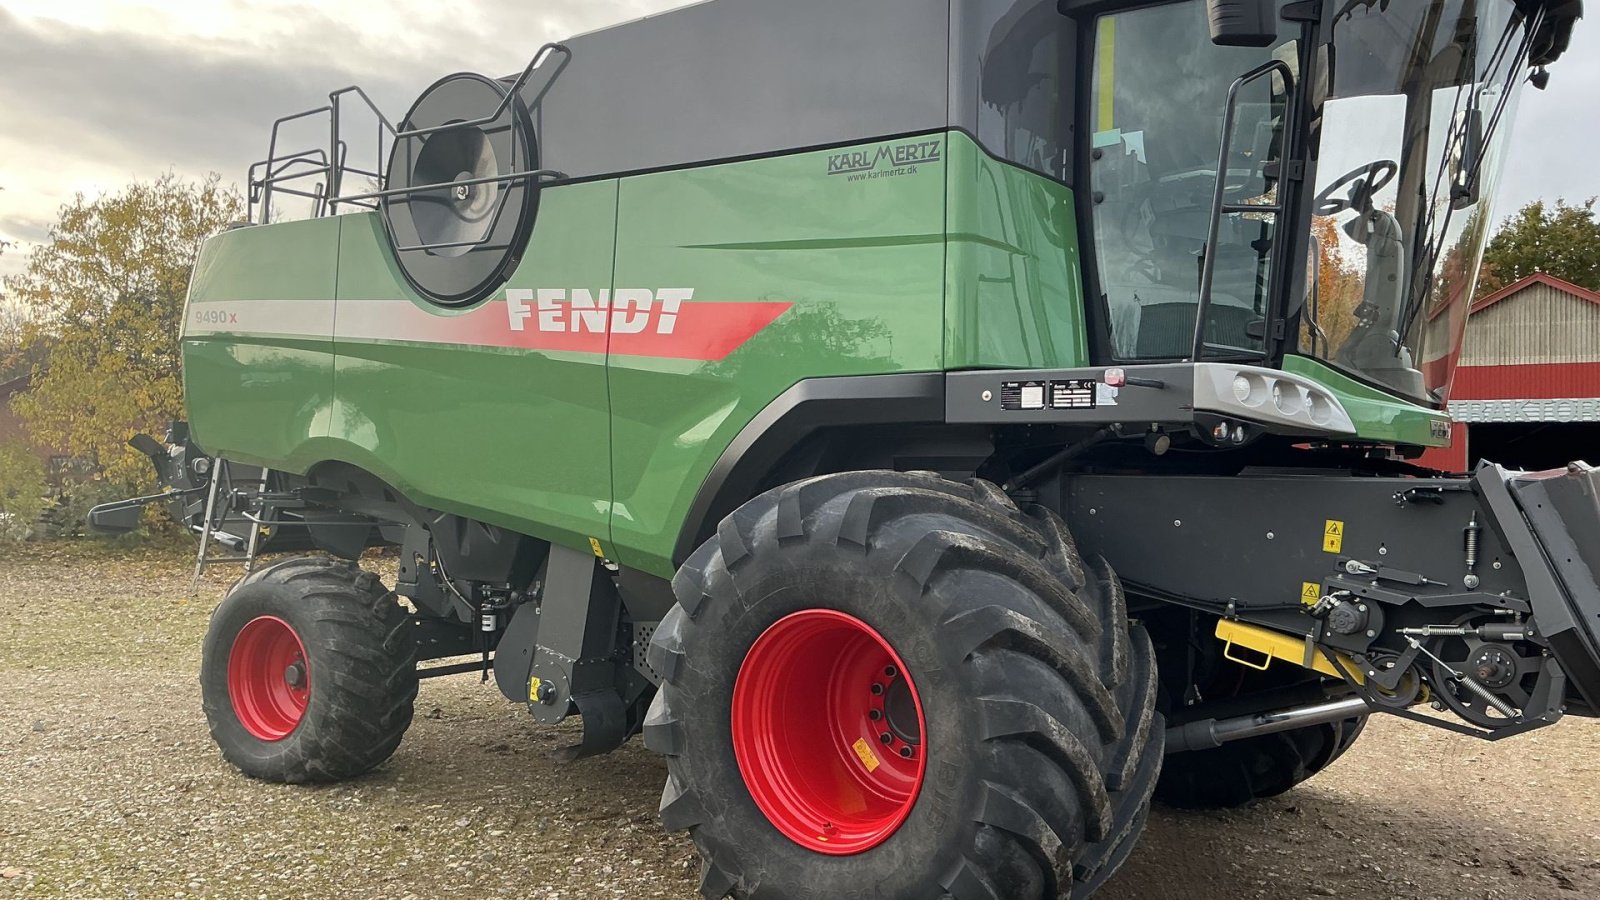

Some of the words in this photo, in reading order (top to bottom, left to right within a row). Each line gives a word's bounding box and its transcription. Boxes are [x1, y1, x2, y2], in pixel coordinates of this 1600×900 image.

[828, 151, 871, 171] KARL
[871, 141, 941, 169] MERTZ
[847, 165, 918, 182] www.karlmertz.dk
[195, 310, 227, 324] 9490
[505, 287, 695, 334] FENDT
